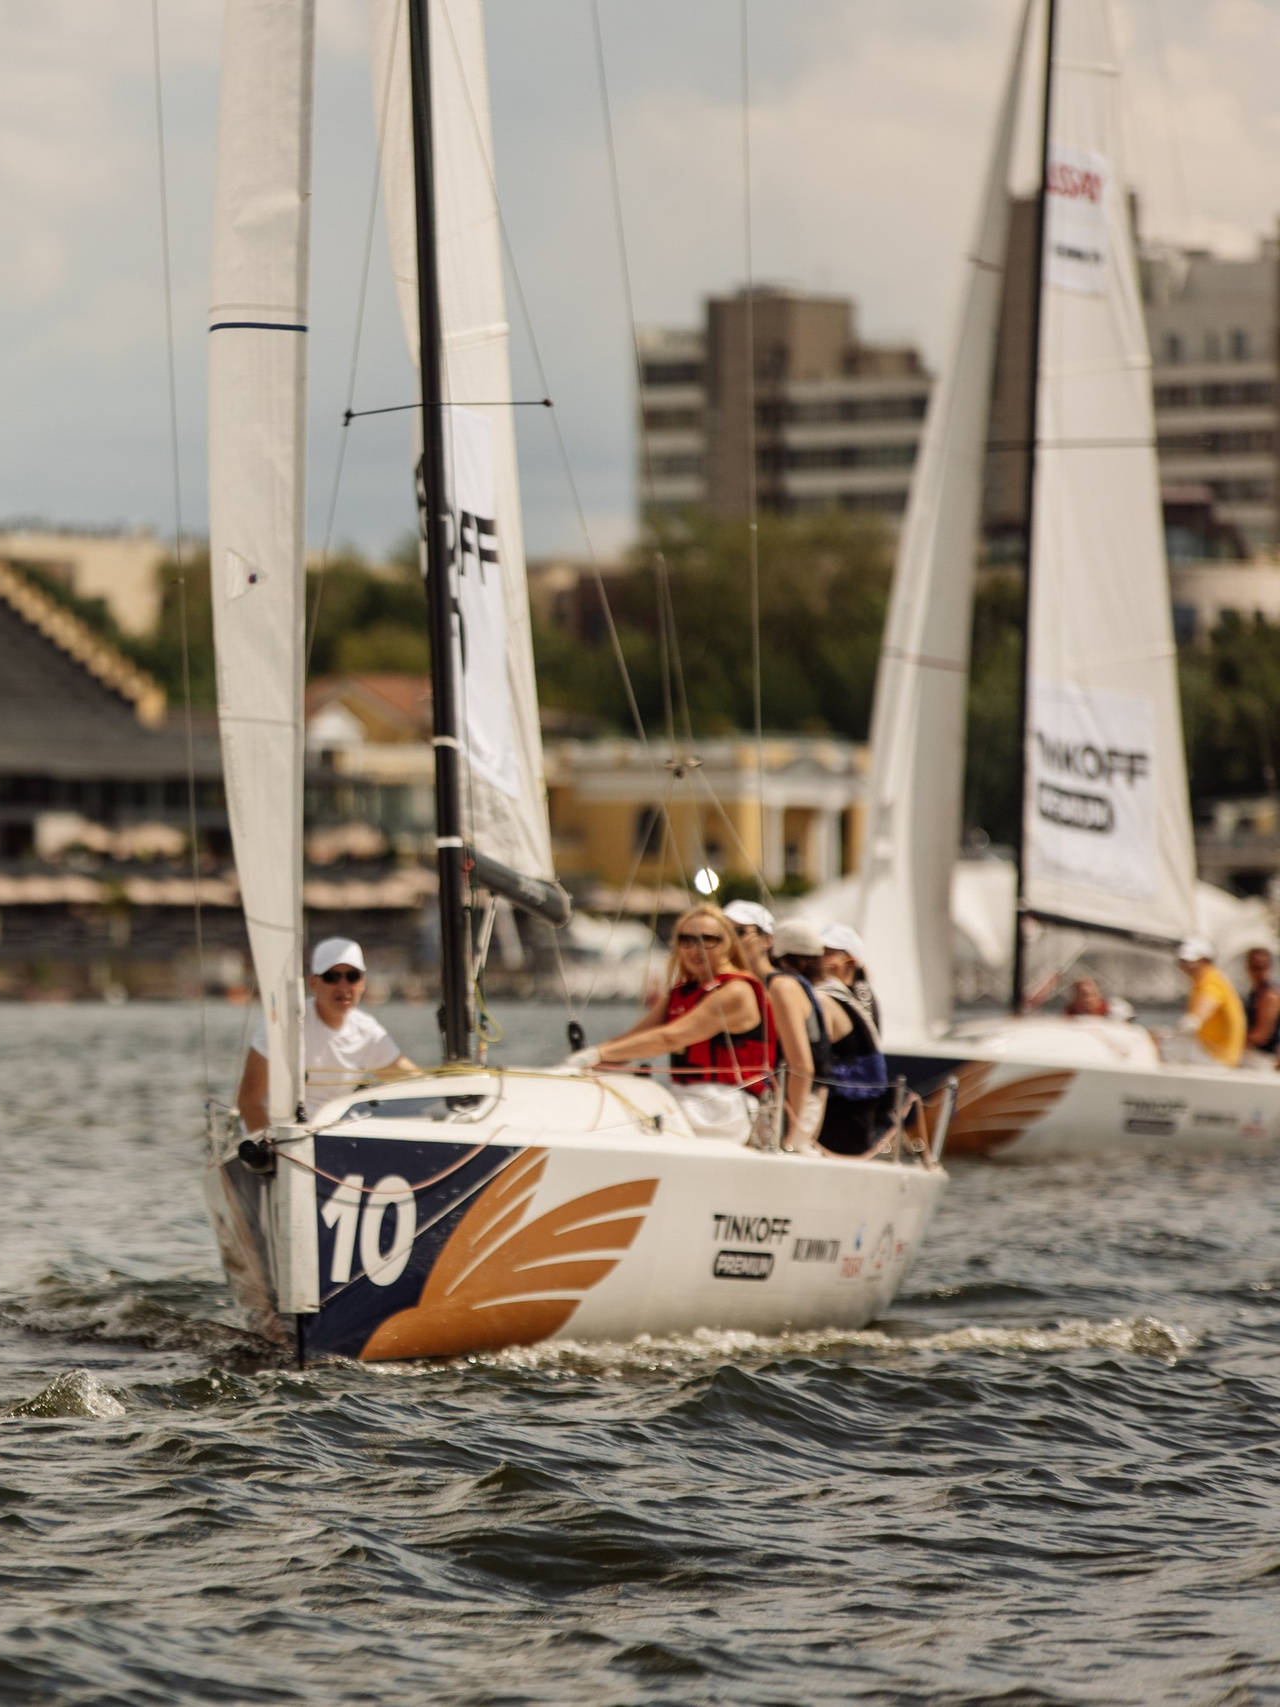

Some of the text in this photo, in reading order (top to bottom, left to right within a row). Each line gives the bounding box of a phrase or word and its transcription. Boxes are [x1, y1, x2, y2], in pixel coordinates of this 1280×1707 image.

[321, 1174, 417, 1287] 10
[713, 1214, 791, 1244] TINKOFF
[716, 1253, 772, 1277] PREMIUM
